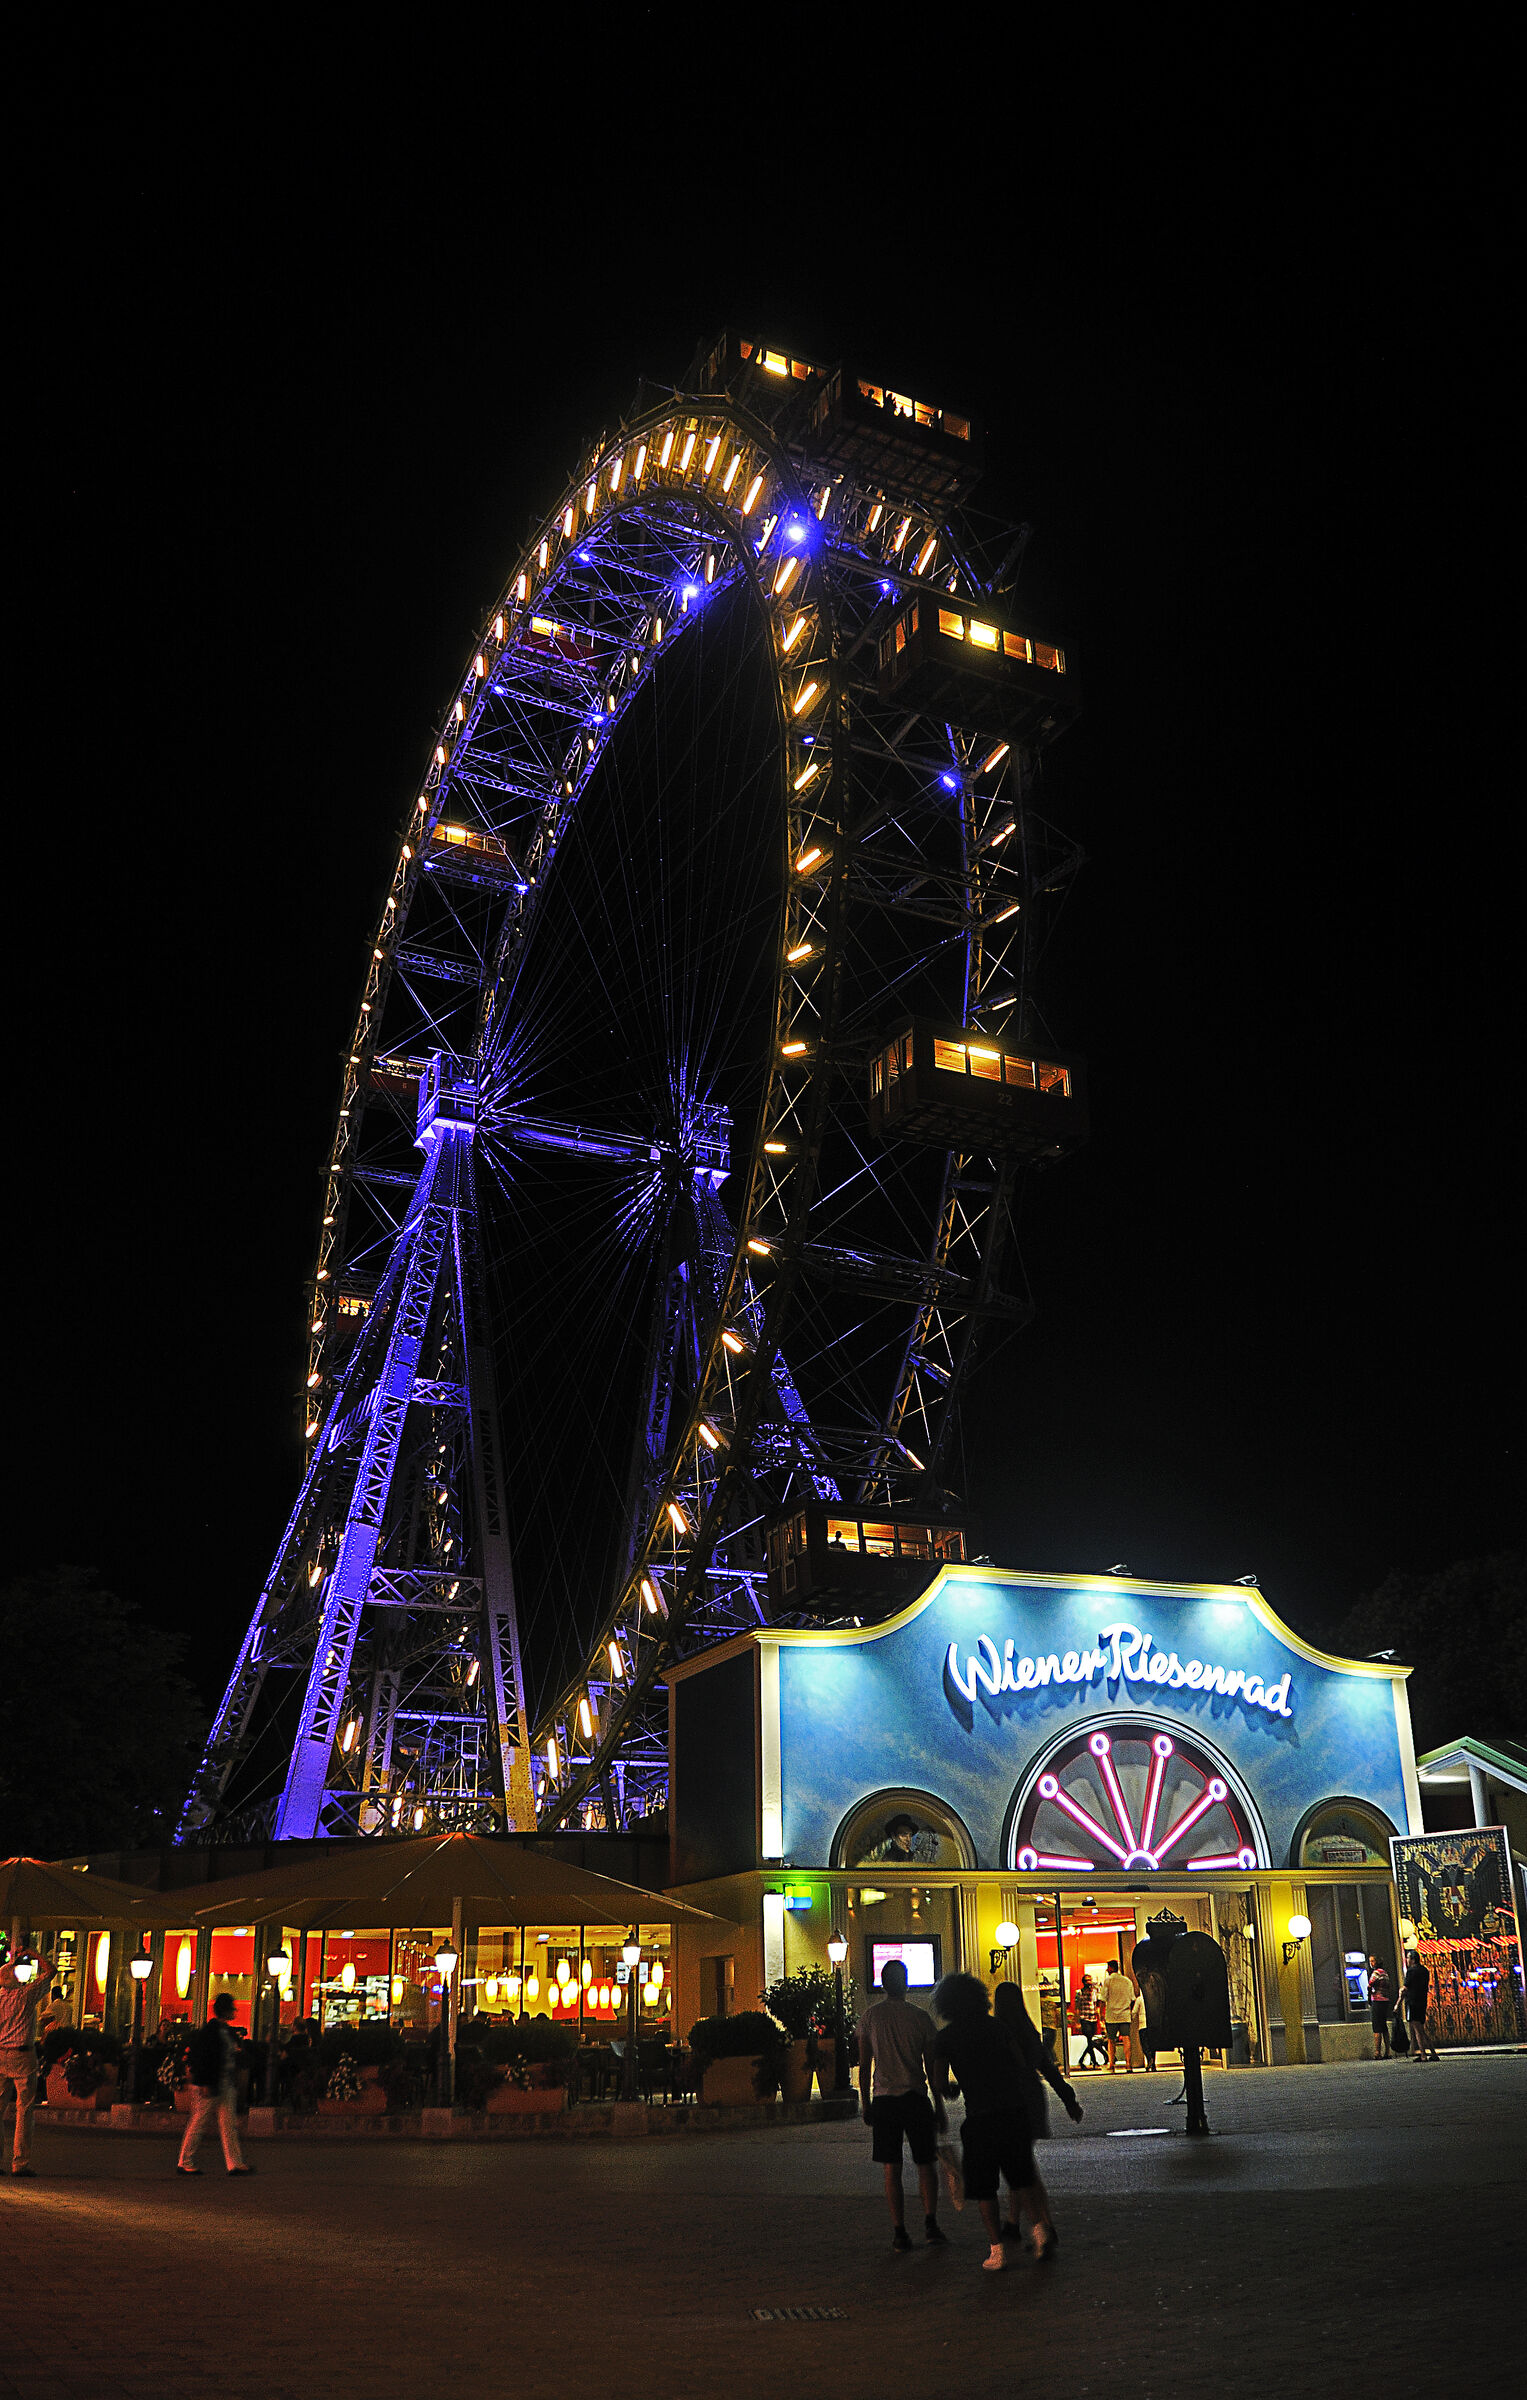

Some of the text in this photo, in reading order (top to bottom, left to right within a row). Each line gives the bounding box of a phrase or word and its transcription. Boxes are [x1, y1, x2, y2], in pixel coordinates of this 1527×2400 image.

[998, 1092, 1013, 1106] 22
[949, 1623, 1293, 1717] Wiener Riesenrad
